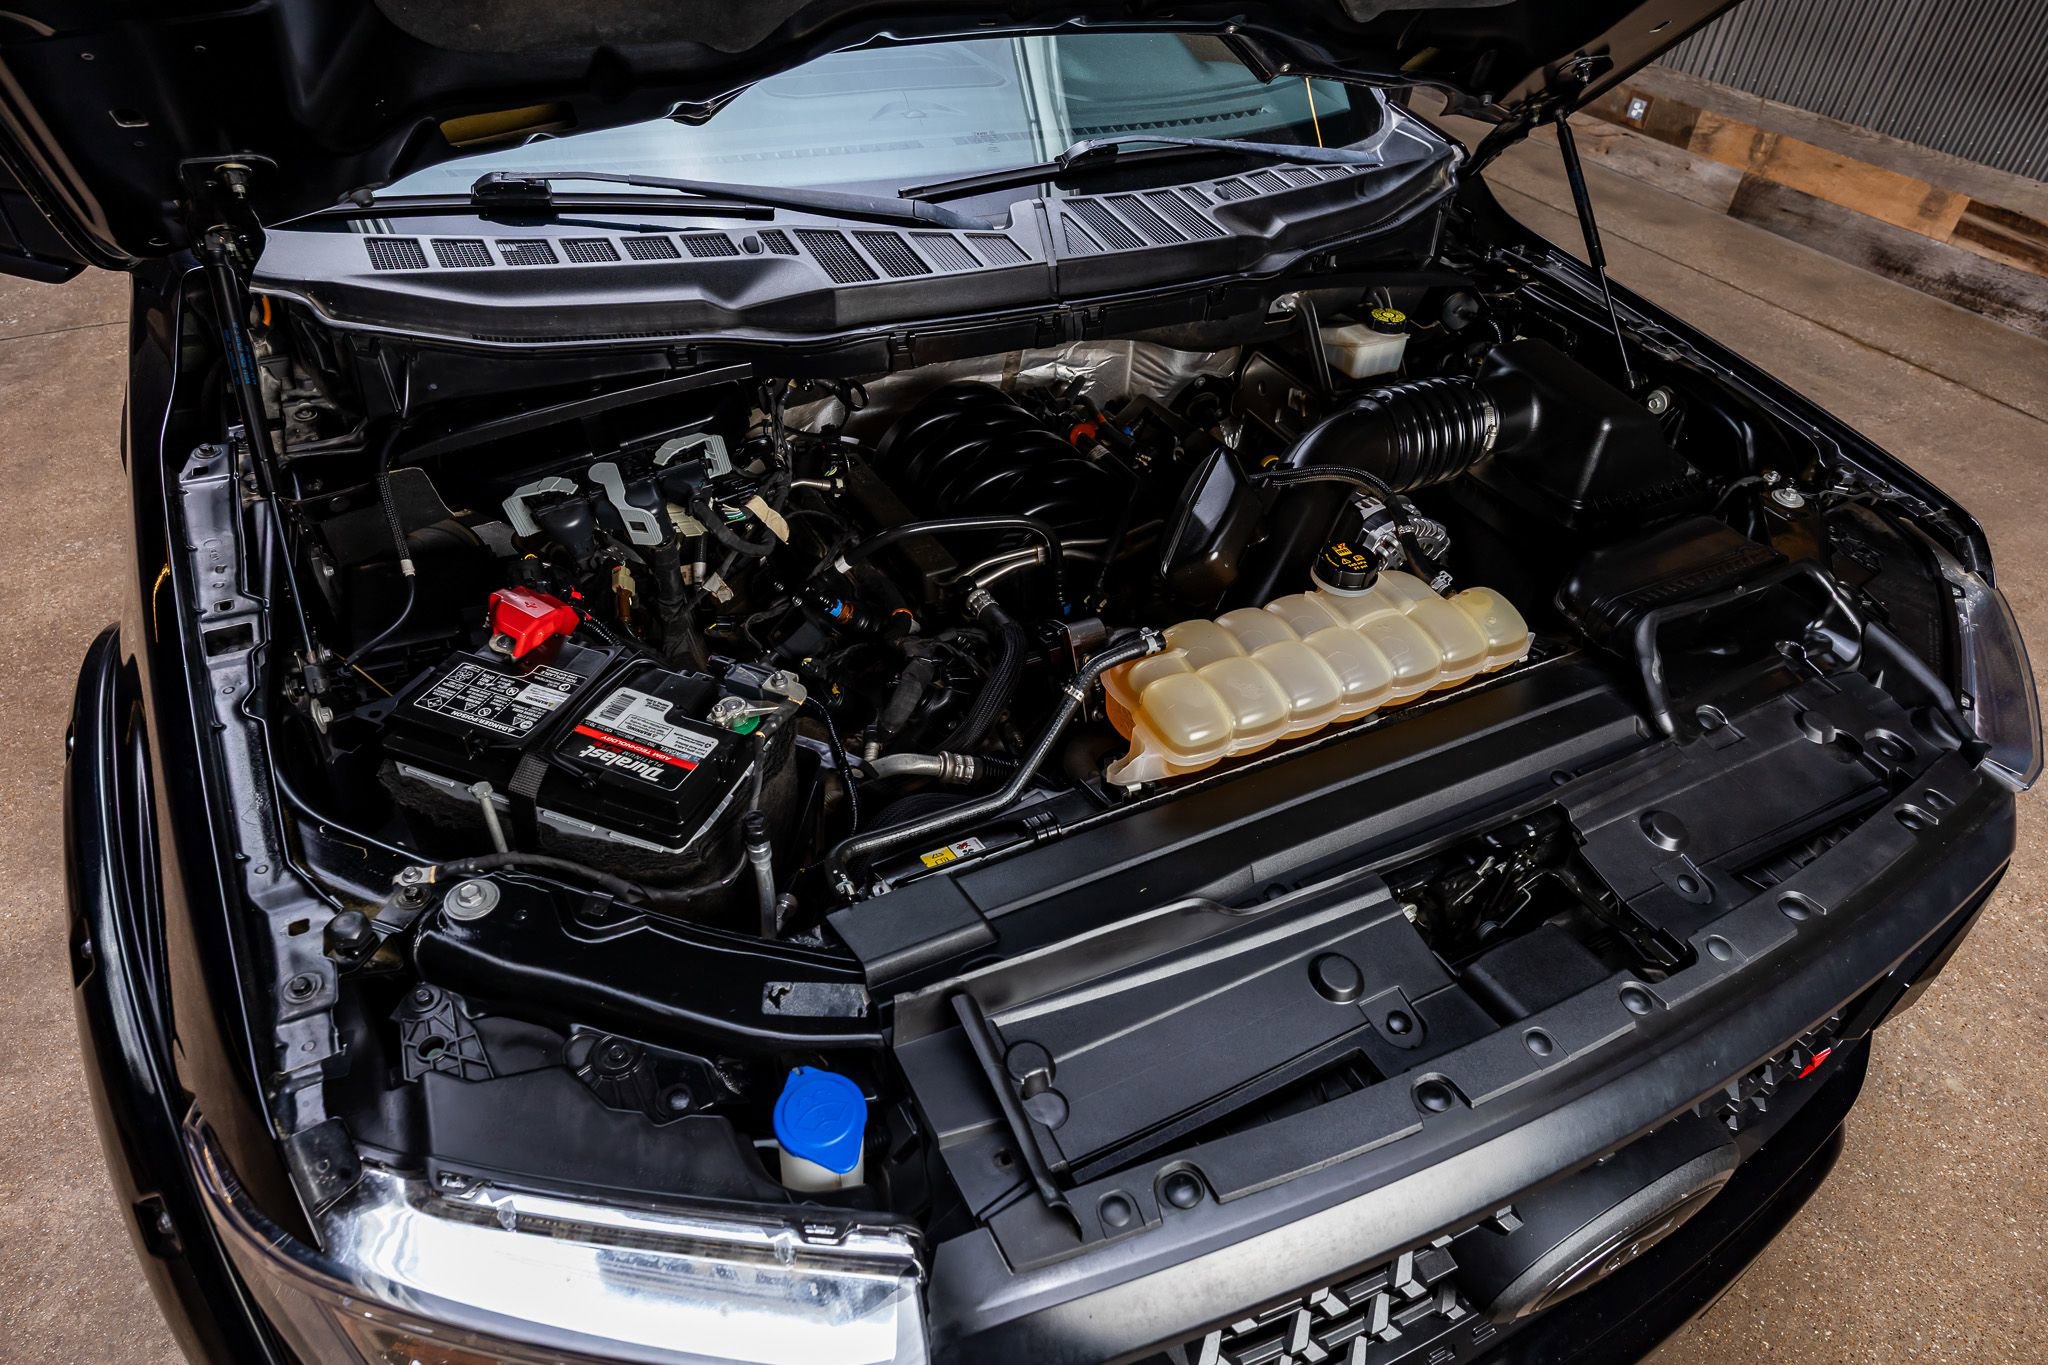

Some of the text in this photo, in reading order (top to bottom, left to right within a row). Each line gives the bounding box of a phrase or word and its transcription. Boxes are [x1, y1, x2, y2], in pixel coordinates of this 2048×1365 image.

[626, 725, 654, 737] WARNING:
[601, 736, 651, 755] TECHNOLOGY
[579, 745, 665, 782] Duralast
[622, 751, 664, 767] PLATINUM
[652, 752, 671, 760] AGM
